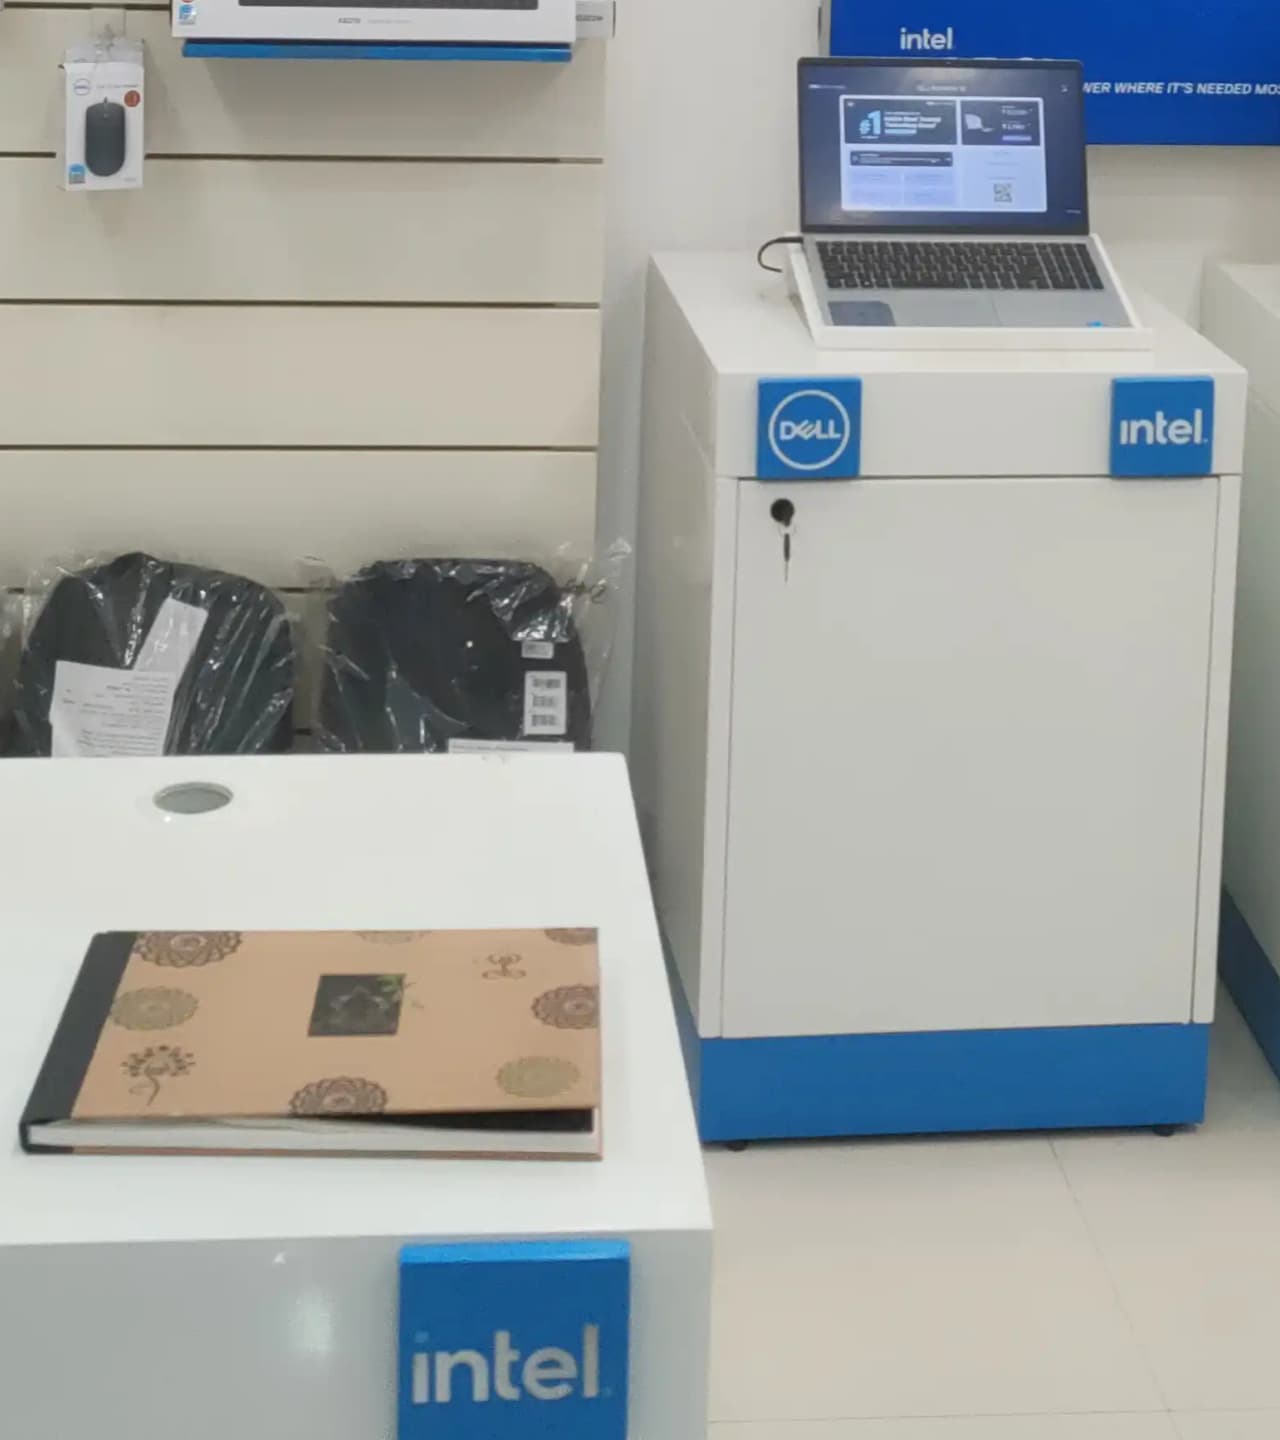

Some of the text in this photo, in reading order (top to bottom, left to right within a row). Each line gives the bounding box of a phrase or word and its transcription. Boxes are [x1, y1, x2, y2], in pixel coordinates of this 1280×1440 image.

[900, 26, 953, 50] intel
[1114, 81, 1165, 94] WHERE
[1167, 81, 1194, 95] IT'S
[1196, 82, 1252, 96] NEEDED
[779, 420, 842, 442] DELL
[1120, 408, 1209, 445] intel
[411, 1322, 613, 1404] intel
